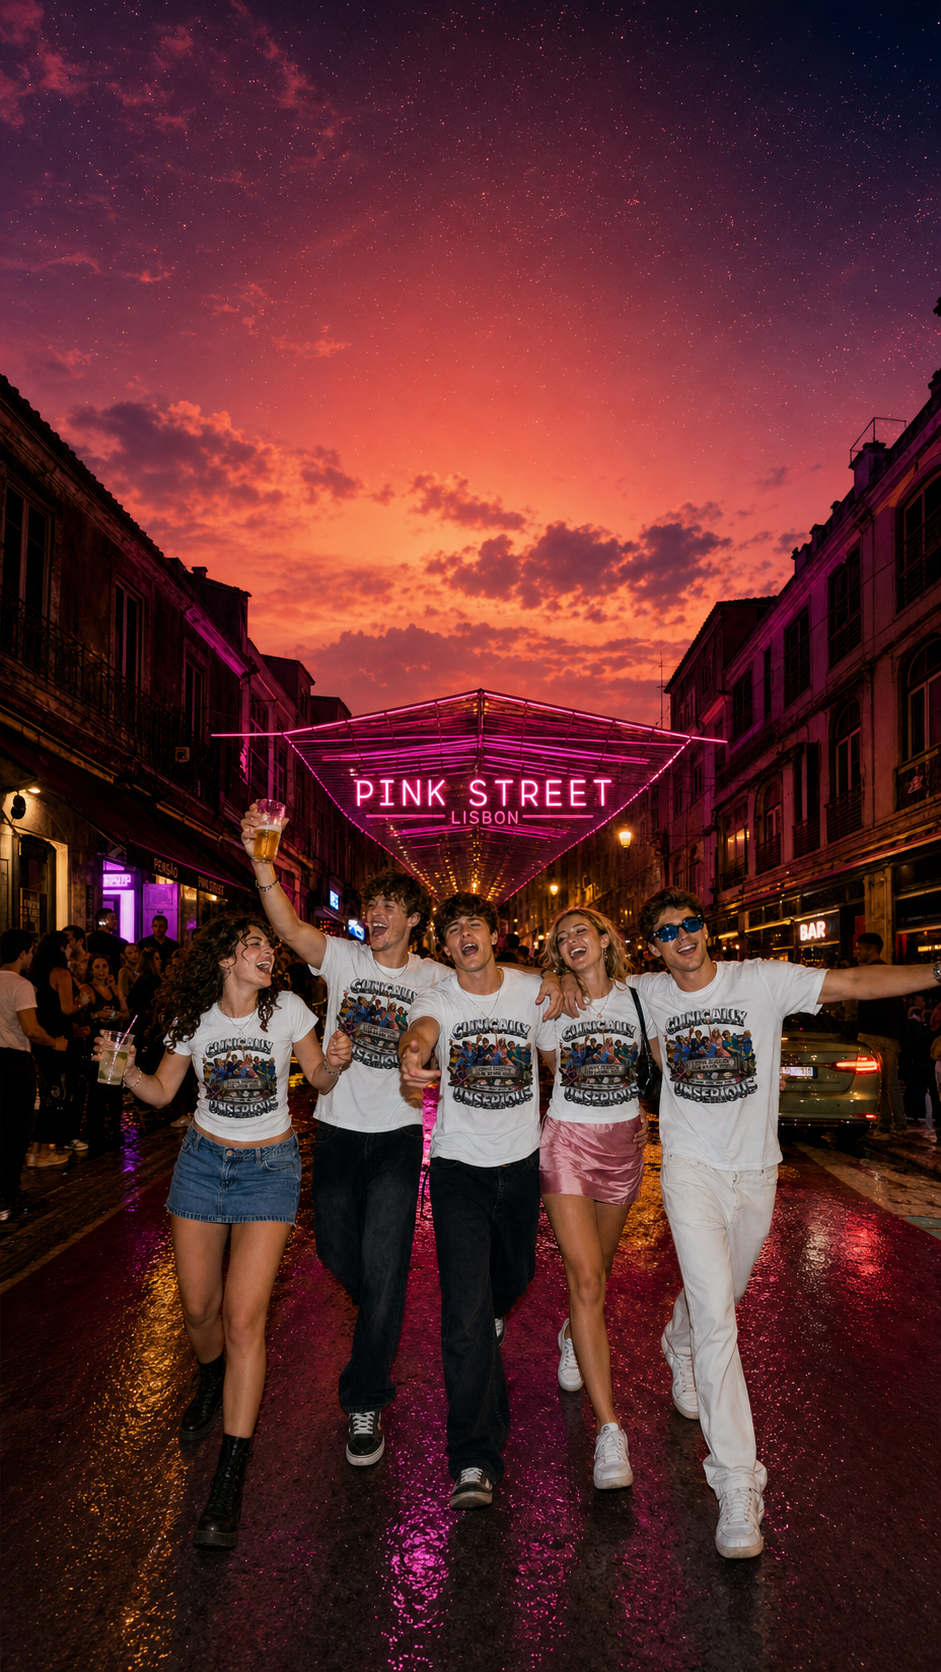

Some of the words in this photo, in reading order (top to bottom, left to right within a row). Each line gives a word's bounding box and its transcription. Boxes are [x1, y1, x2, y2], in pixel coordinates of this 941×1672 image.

[355, 779, 446, 807] PINK
[469, 779, 612, 807] STREET
[451, 810, 519, 825] LISBON
[799, 920, 827, 942] BAR
[452, 1018, 531, 1040] CLINICALLY
[562, 1020, 637, 1042] CLINICALLY
[665, 1008, 748, 1035] CLINICALLY
[453, 1086, 533, 1110] UNSERIOUS
[674, 1077, 758, 1104] UNSERIOUS
